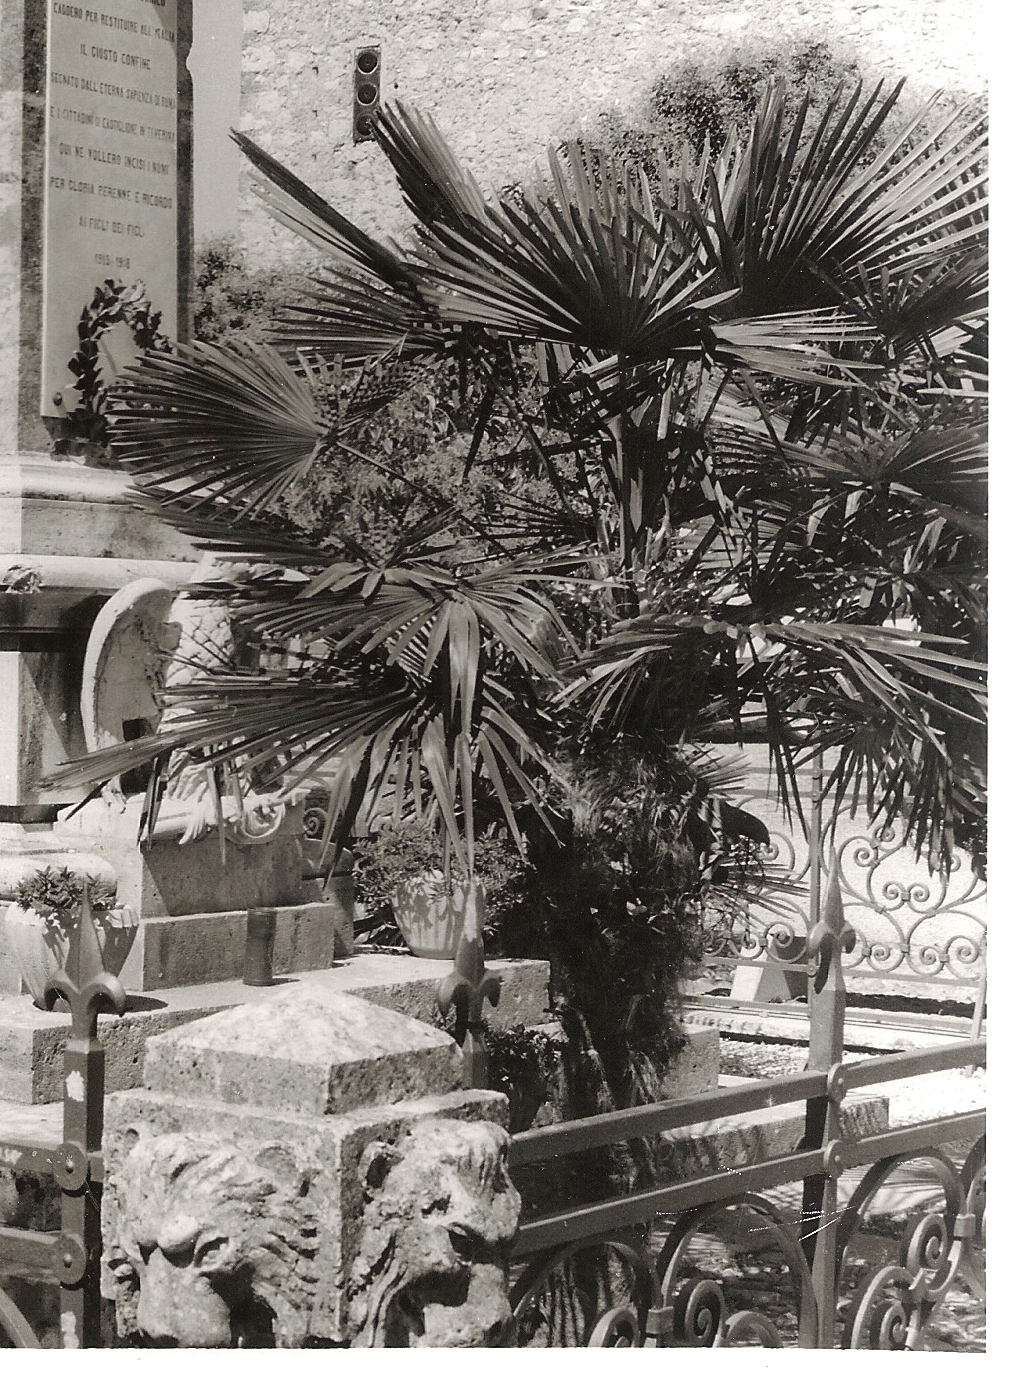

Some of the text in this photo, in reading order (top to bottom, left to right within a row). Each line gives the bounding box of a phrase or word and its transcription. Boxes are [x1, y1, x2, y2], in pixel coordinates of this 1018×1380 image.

[53, 2, 82, 19] CADDERO
[85, 9, 97, 23] PER
[100, 14, 137, 33] RESTITUIRE
[121, 54, 150, 69] CONFINE
[88, 148, 120, 165] VOLLERO
[49, 176, 65, 189] PER
[98, 184, 130, 201] PERENNE
[142, 192, 172, 209] RICORDO
